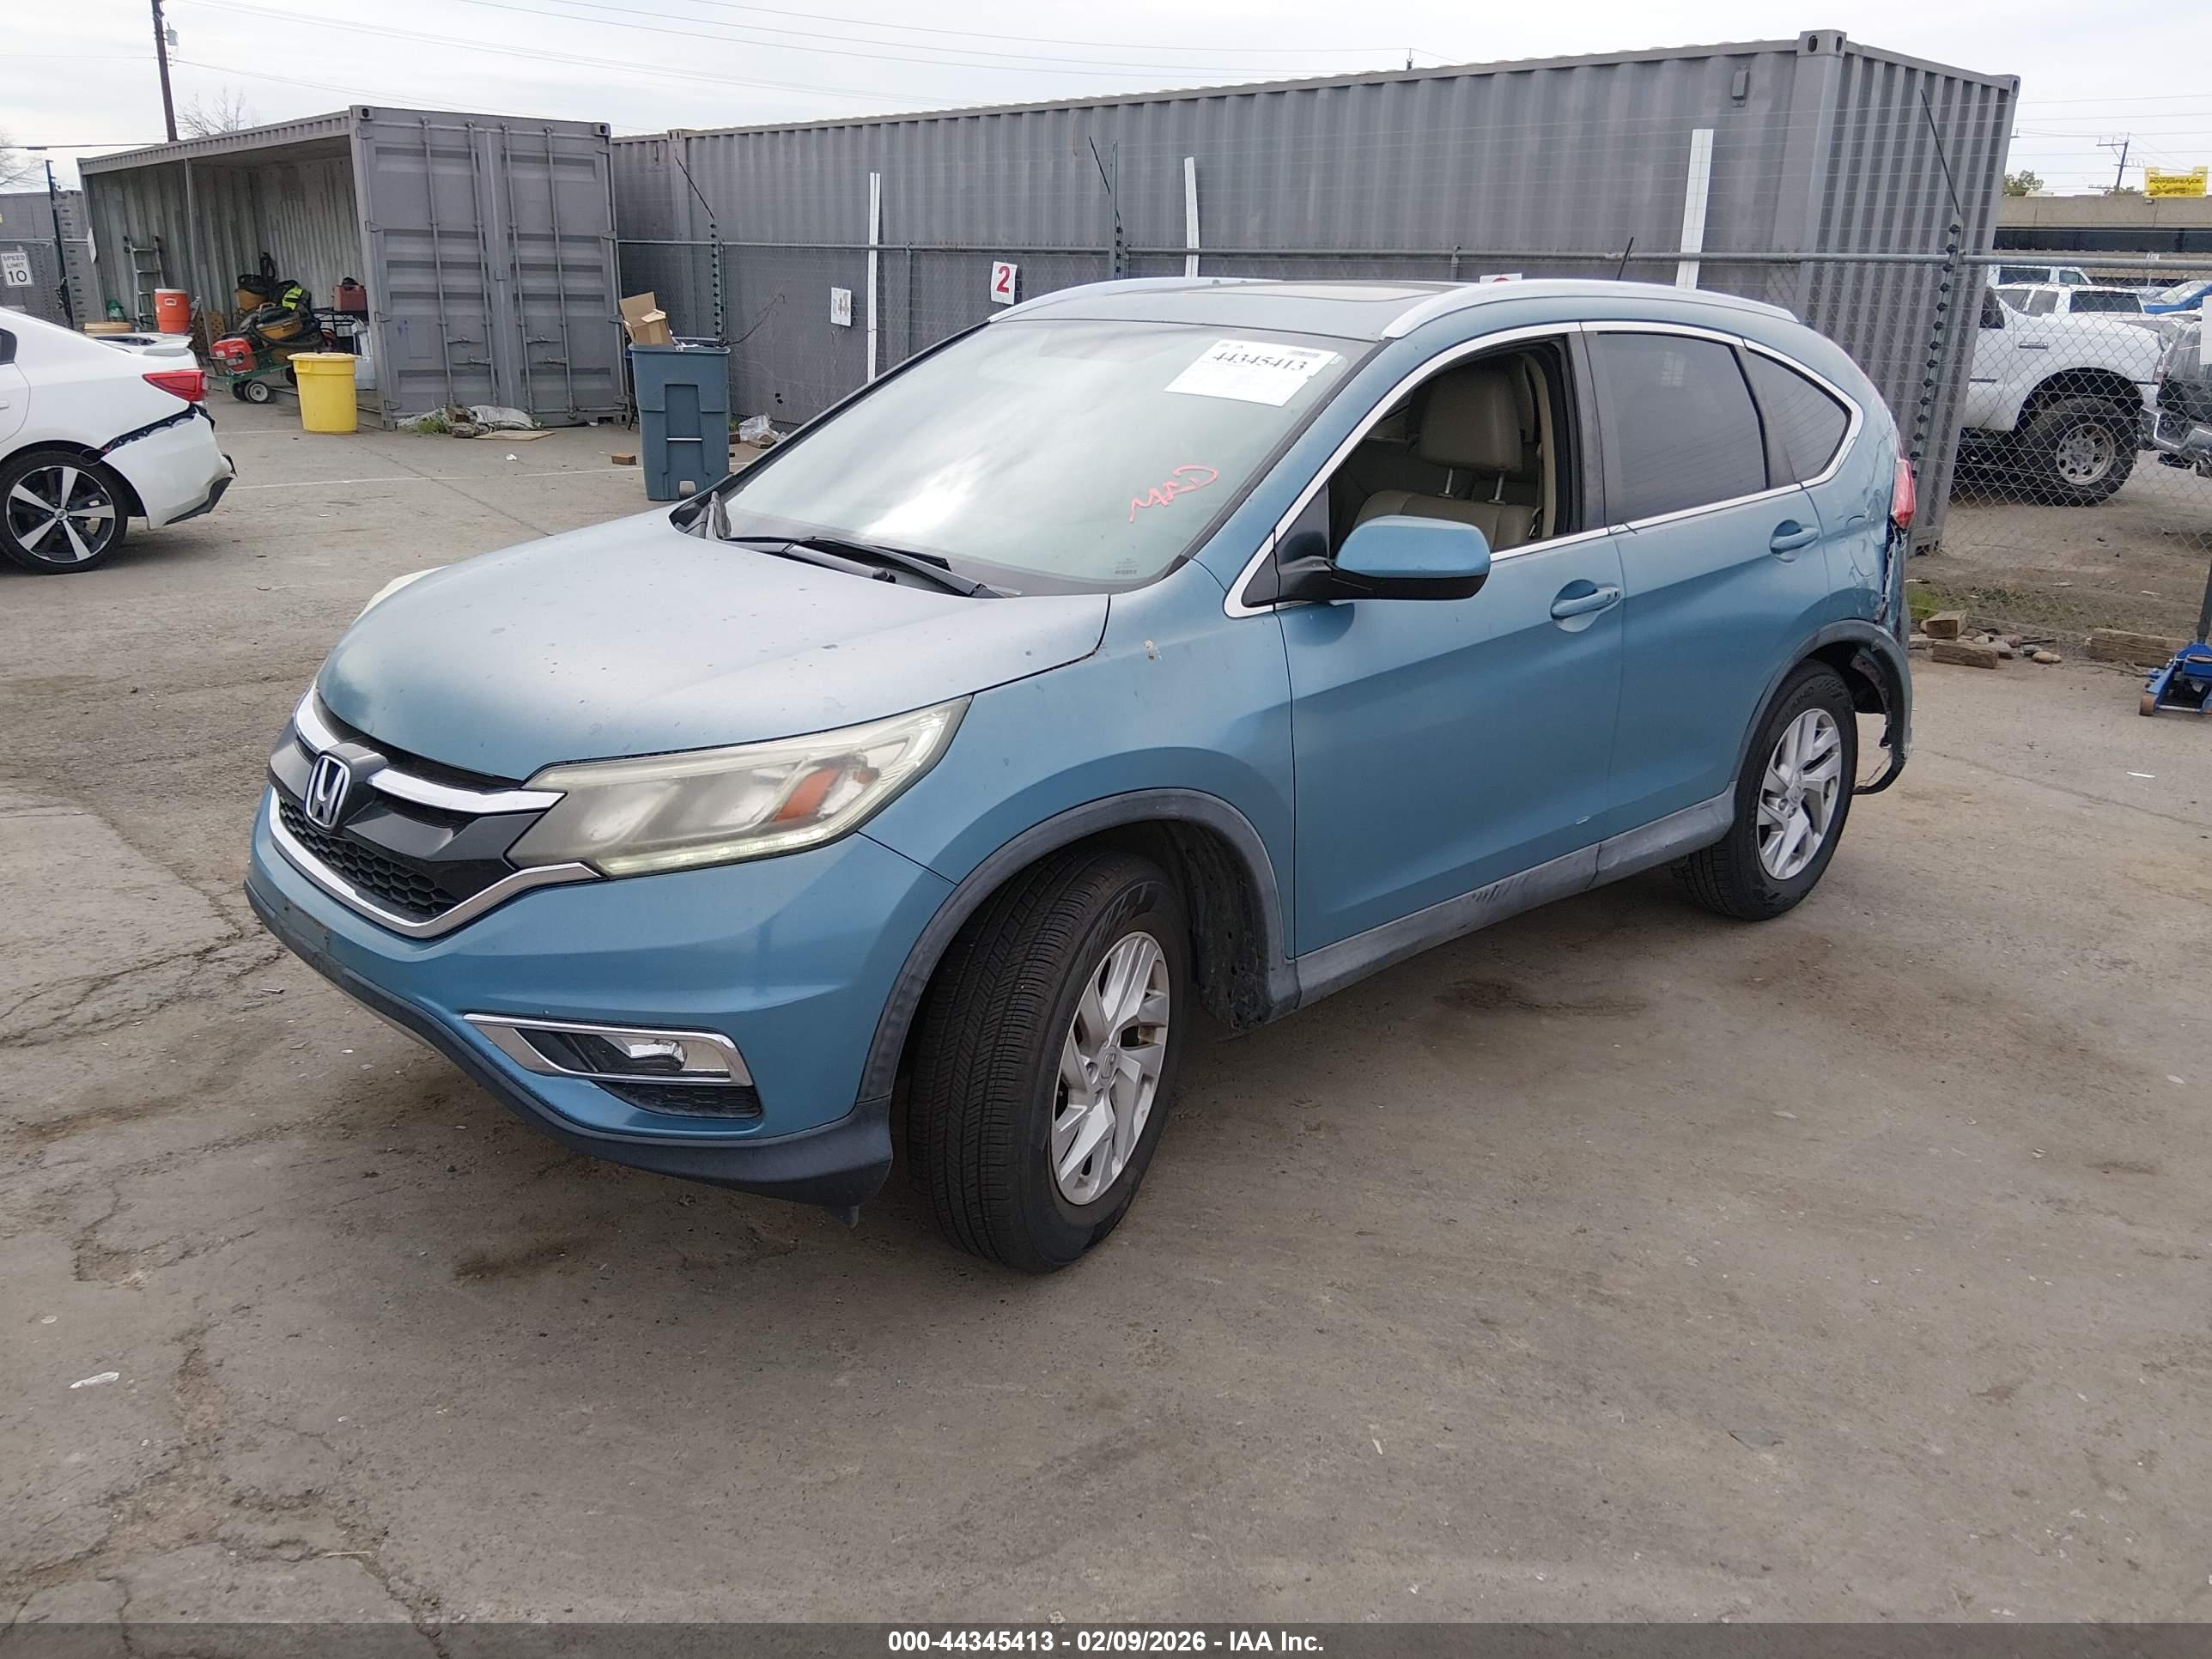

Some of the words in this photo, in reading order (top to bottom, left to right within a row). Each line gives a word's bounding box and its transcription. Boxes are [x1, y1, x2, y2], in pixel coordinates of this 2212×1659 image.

[9, 270, 27, 283] 10
[996, 265, 1010, 294] 2
[1212, 351, 1308, 372] 44345413
